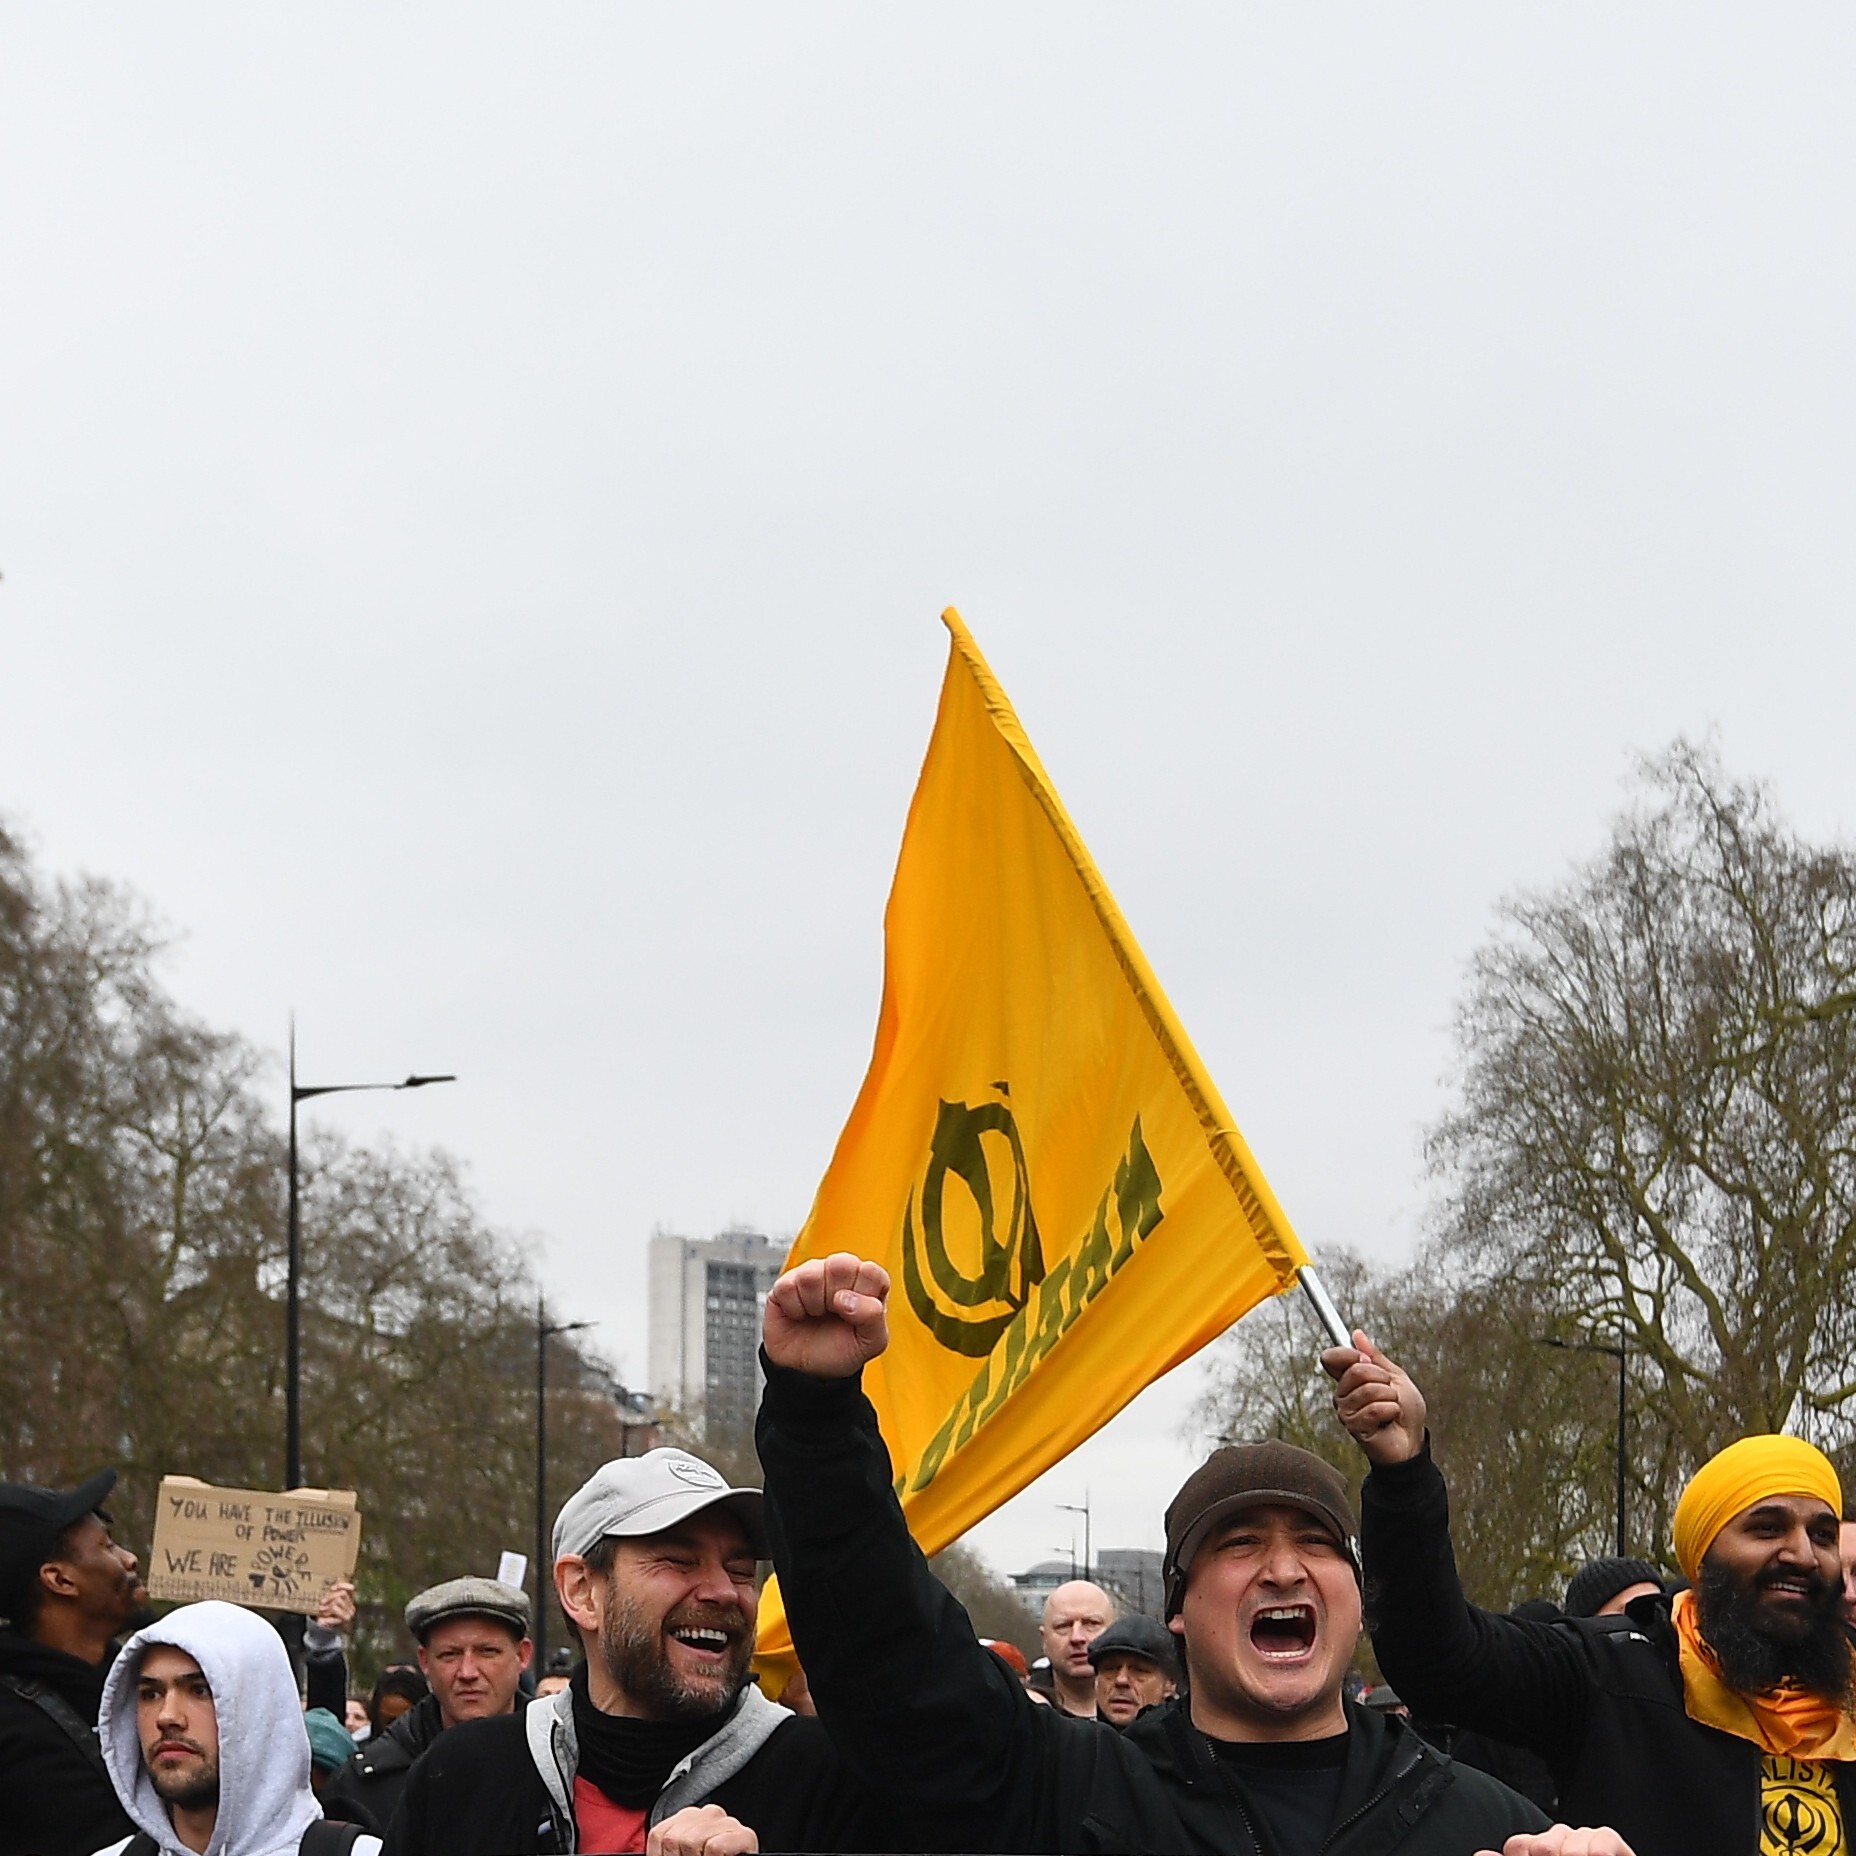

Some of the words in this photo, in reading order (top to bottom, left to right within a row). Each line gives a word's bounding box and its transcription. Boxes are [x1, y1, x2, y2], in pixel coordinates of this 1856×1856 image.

[170, 1496, 208, 1520] YOU
[219, 1502, 252, 1522] HAVE
[265, 1507, 291, 1525] THE
[235, 1524, 255, 1542] OF
[263, 1525, 306, 1543] POWER
[165, 1548, 202, 1575] WE
[209, 1552, 238, 1578] ARE
